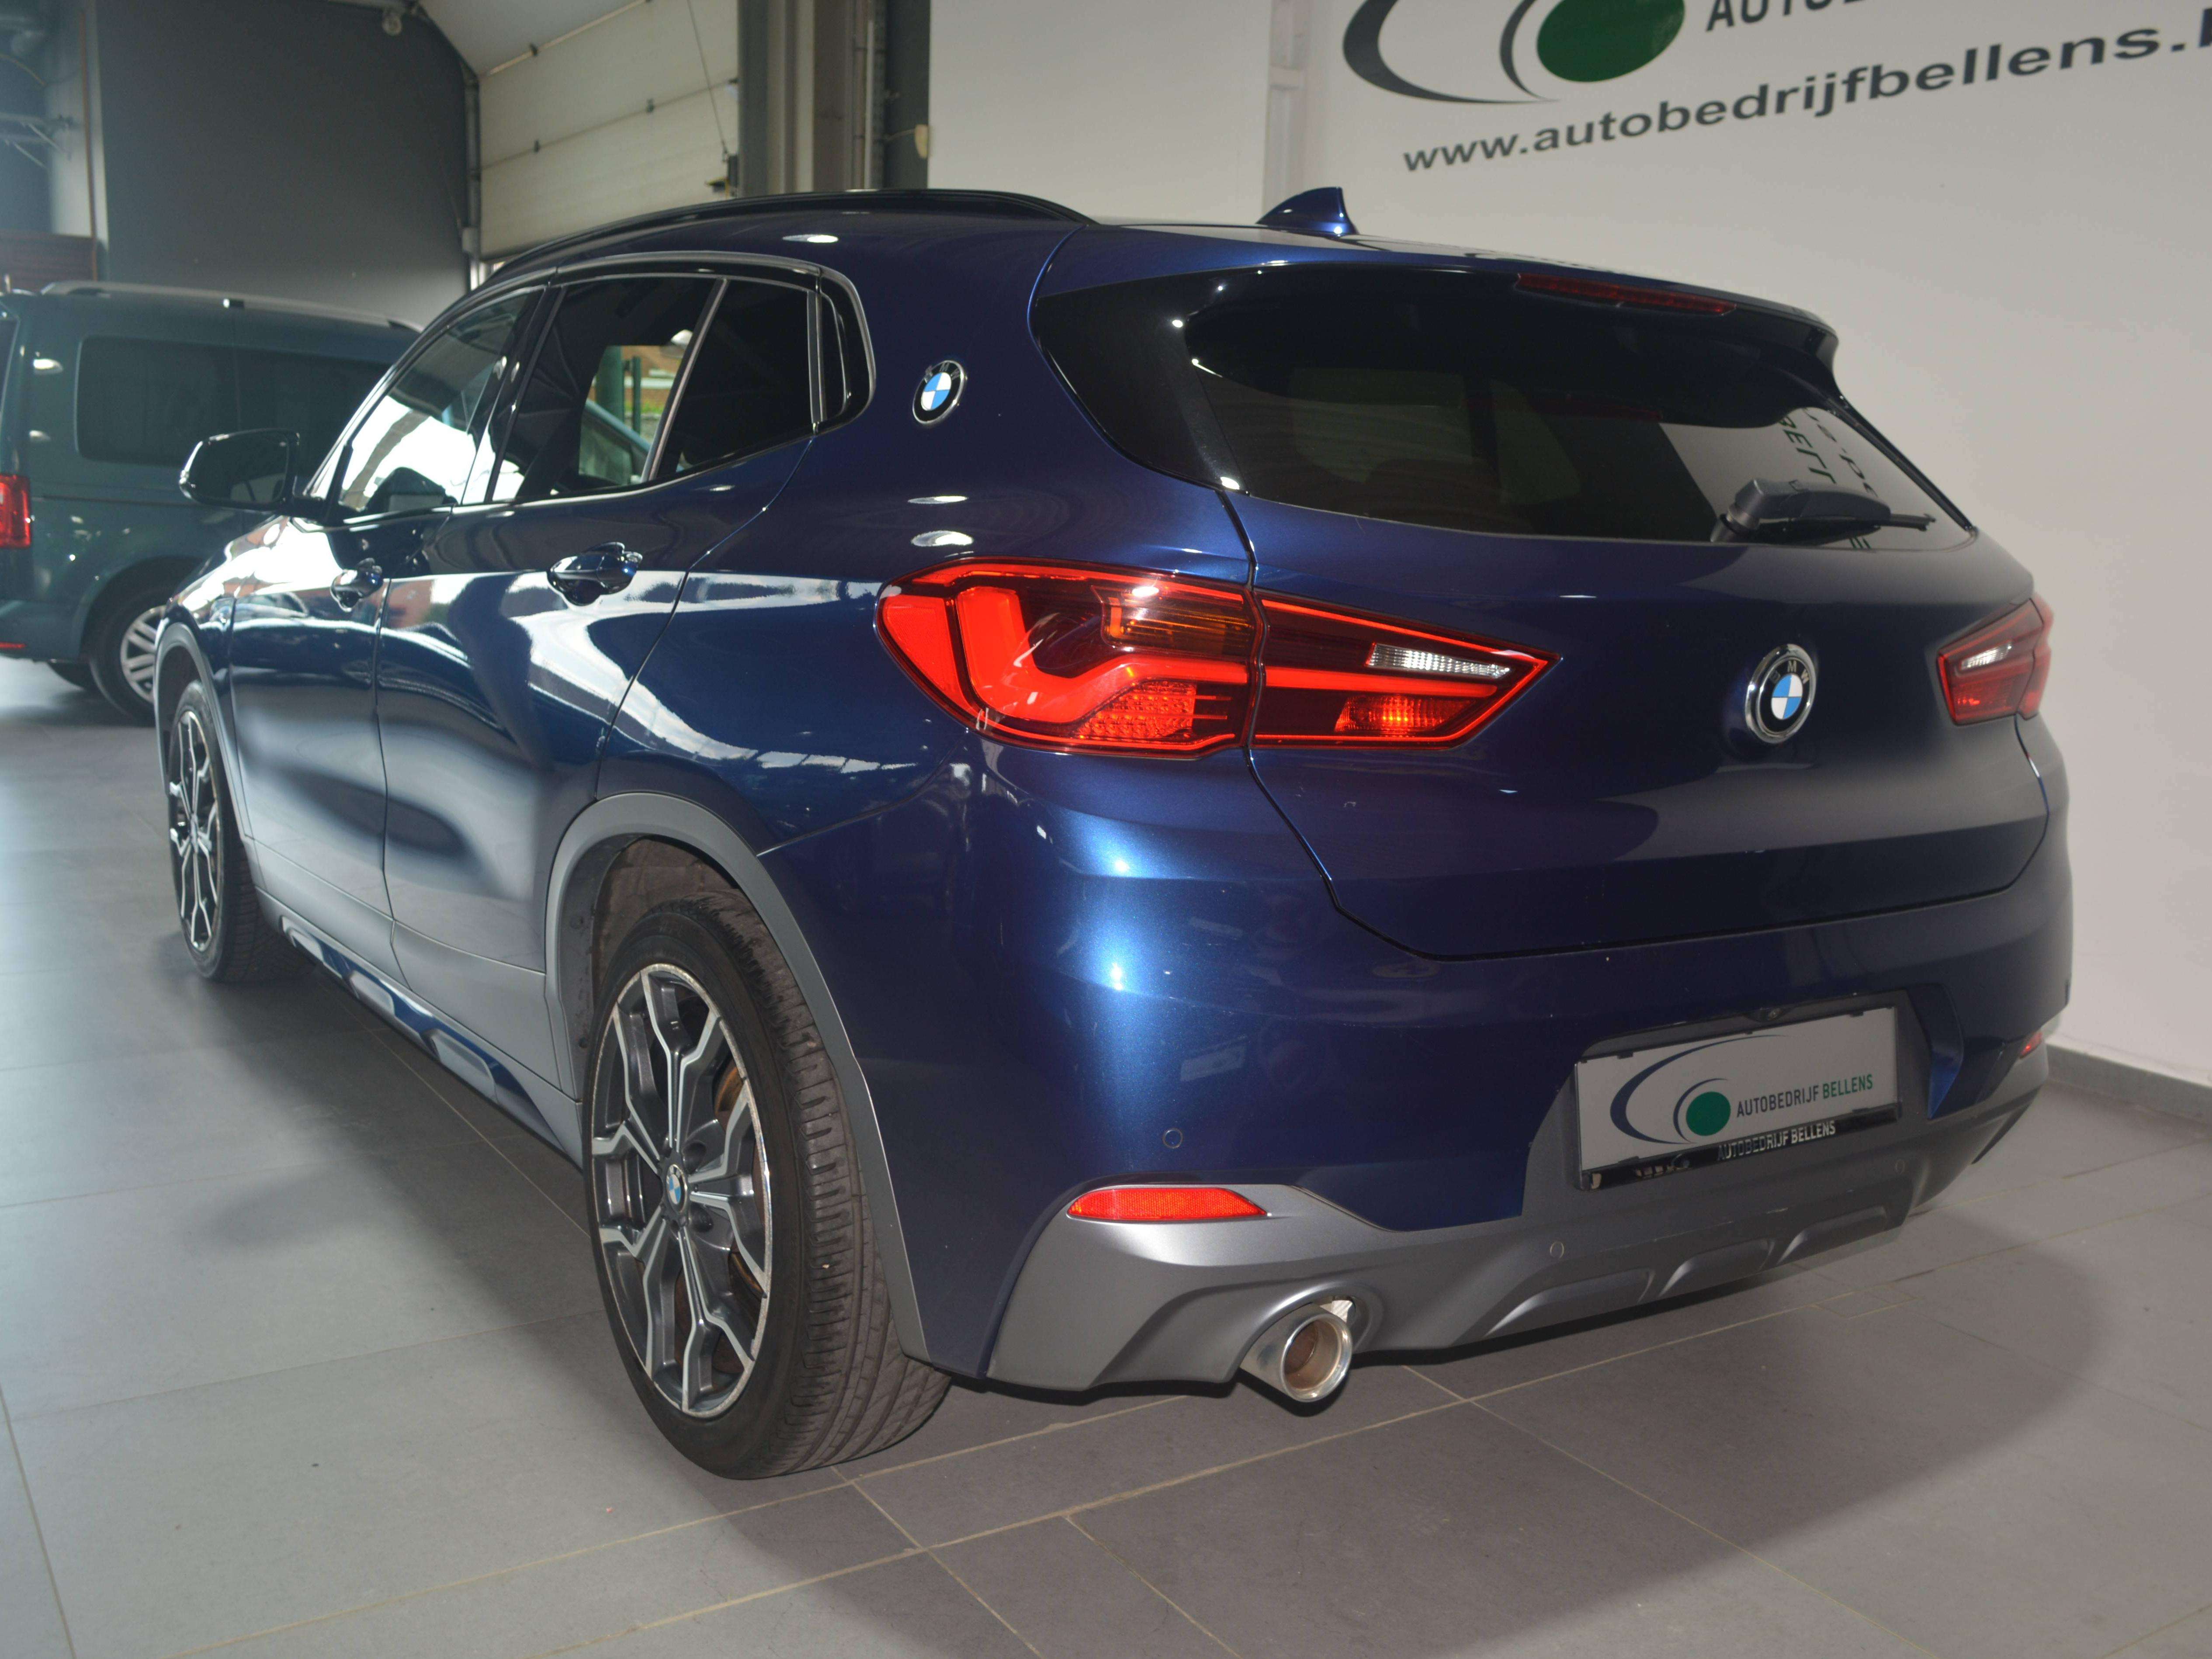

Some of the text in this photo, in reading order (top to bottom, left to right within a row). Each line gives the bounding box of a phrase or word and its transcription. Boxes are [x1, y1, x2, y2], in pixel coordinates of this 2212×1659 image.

[1737, 1074, 1873, 1118] AUTOBEDRIJF BELLENS
[1717, 1120, 1836, 1160] AUTOBEDRIJF BELLENS
